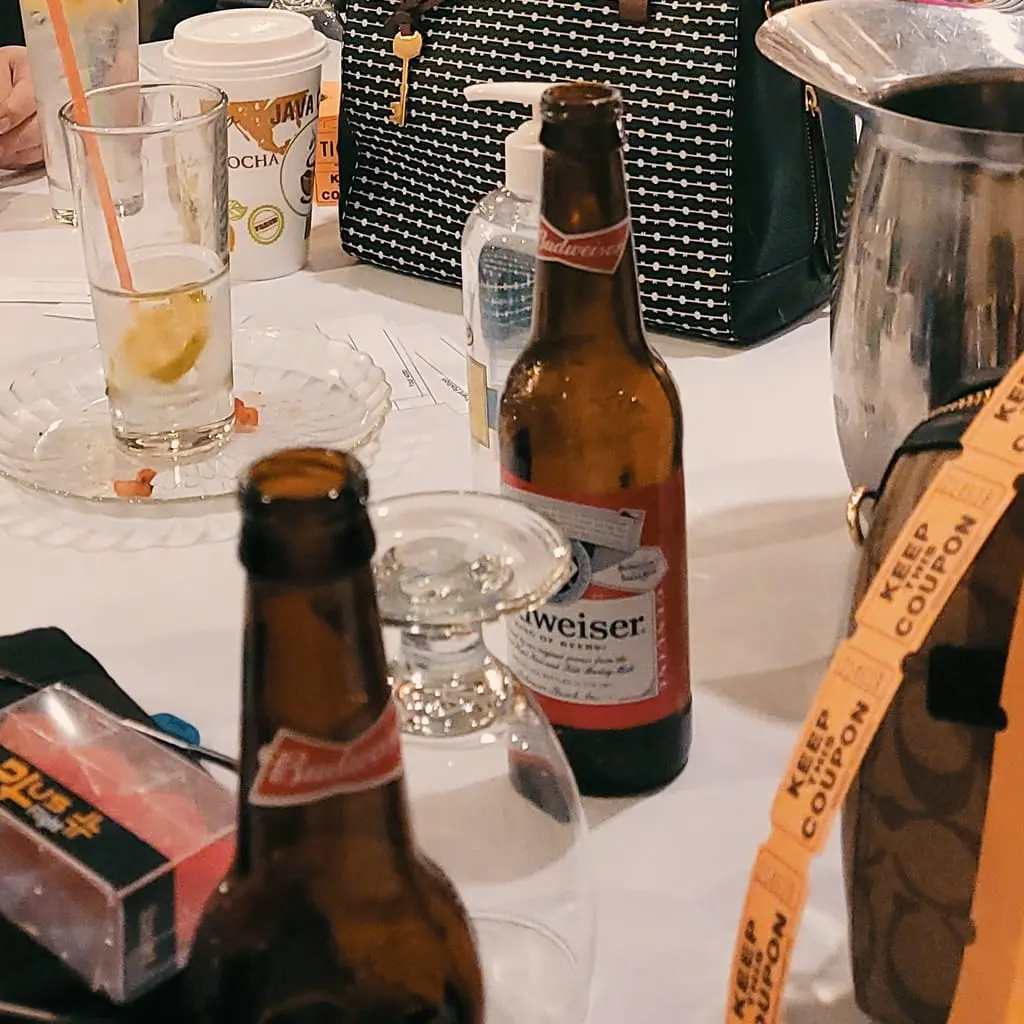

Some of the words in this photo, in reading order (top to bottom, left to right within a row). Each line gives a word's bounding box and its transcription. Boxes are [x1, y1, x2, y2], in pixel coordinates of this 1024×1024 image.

[271, 93, 314, 125] JAVA
[228, 153, 280, 170] OCHA
[880, 522, 929, 603] KEEP
[895, 514, 977, 637] COUPON
[787, 709, 829, 798] KEEP
[802, 700, 869, 839] COUPON
[733, 919, 757, 1020] KEEP
